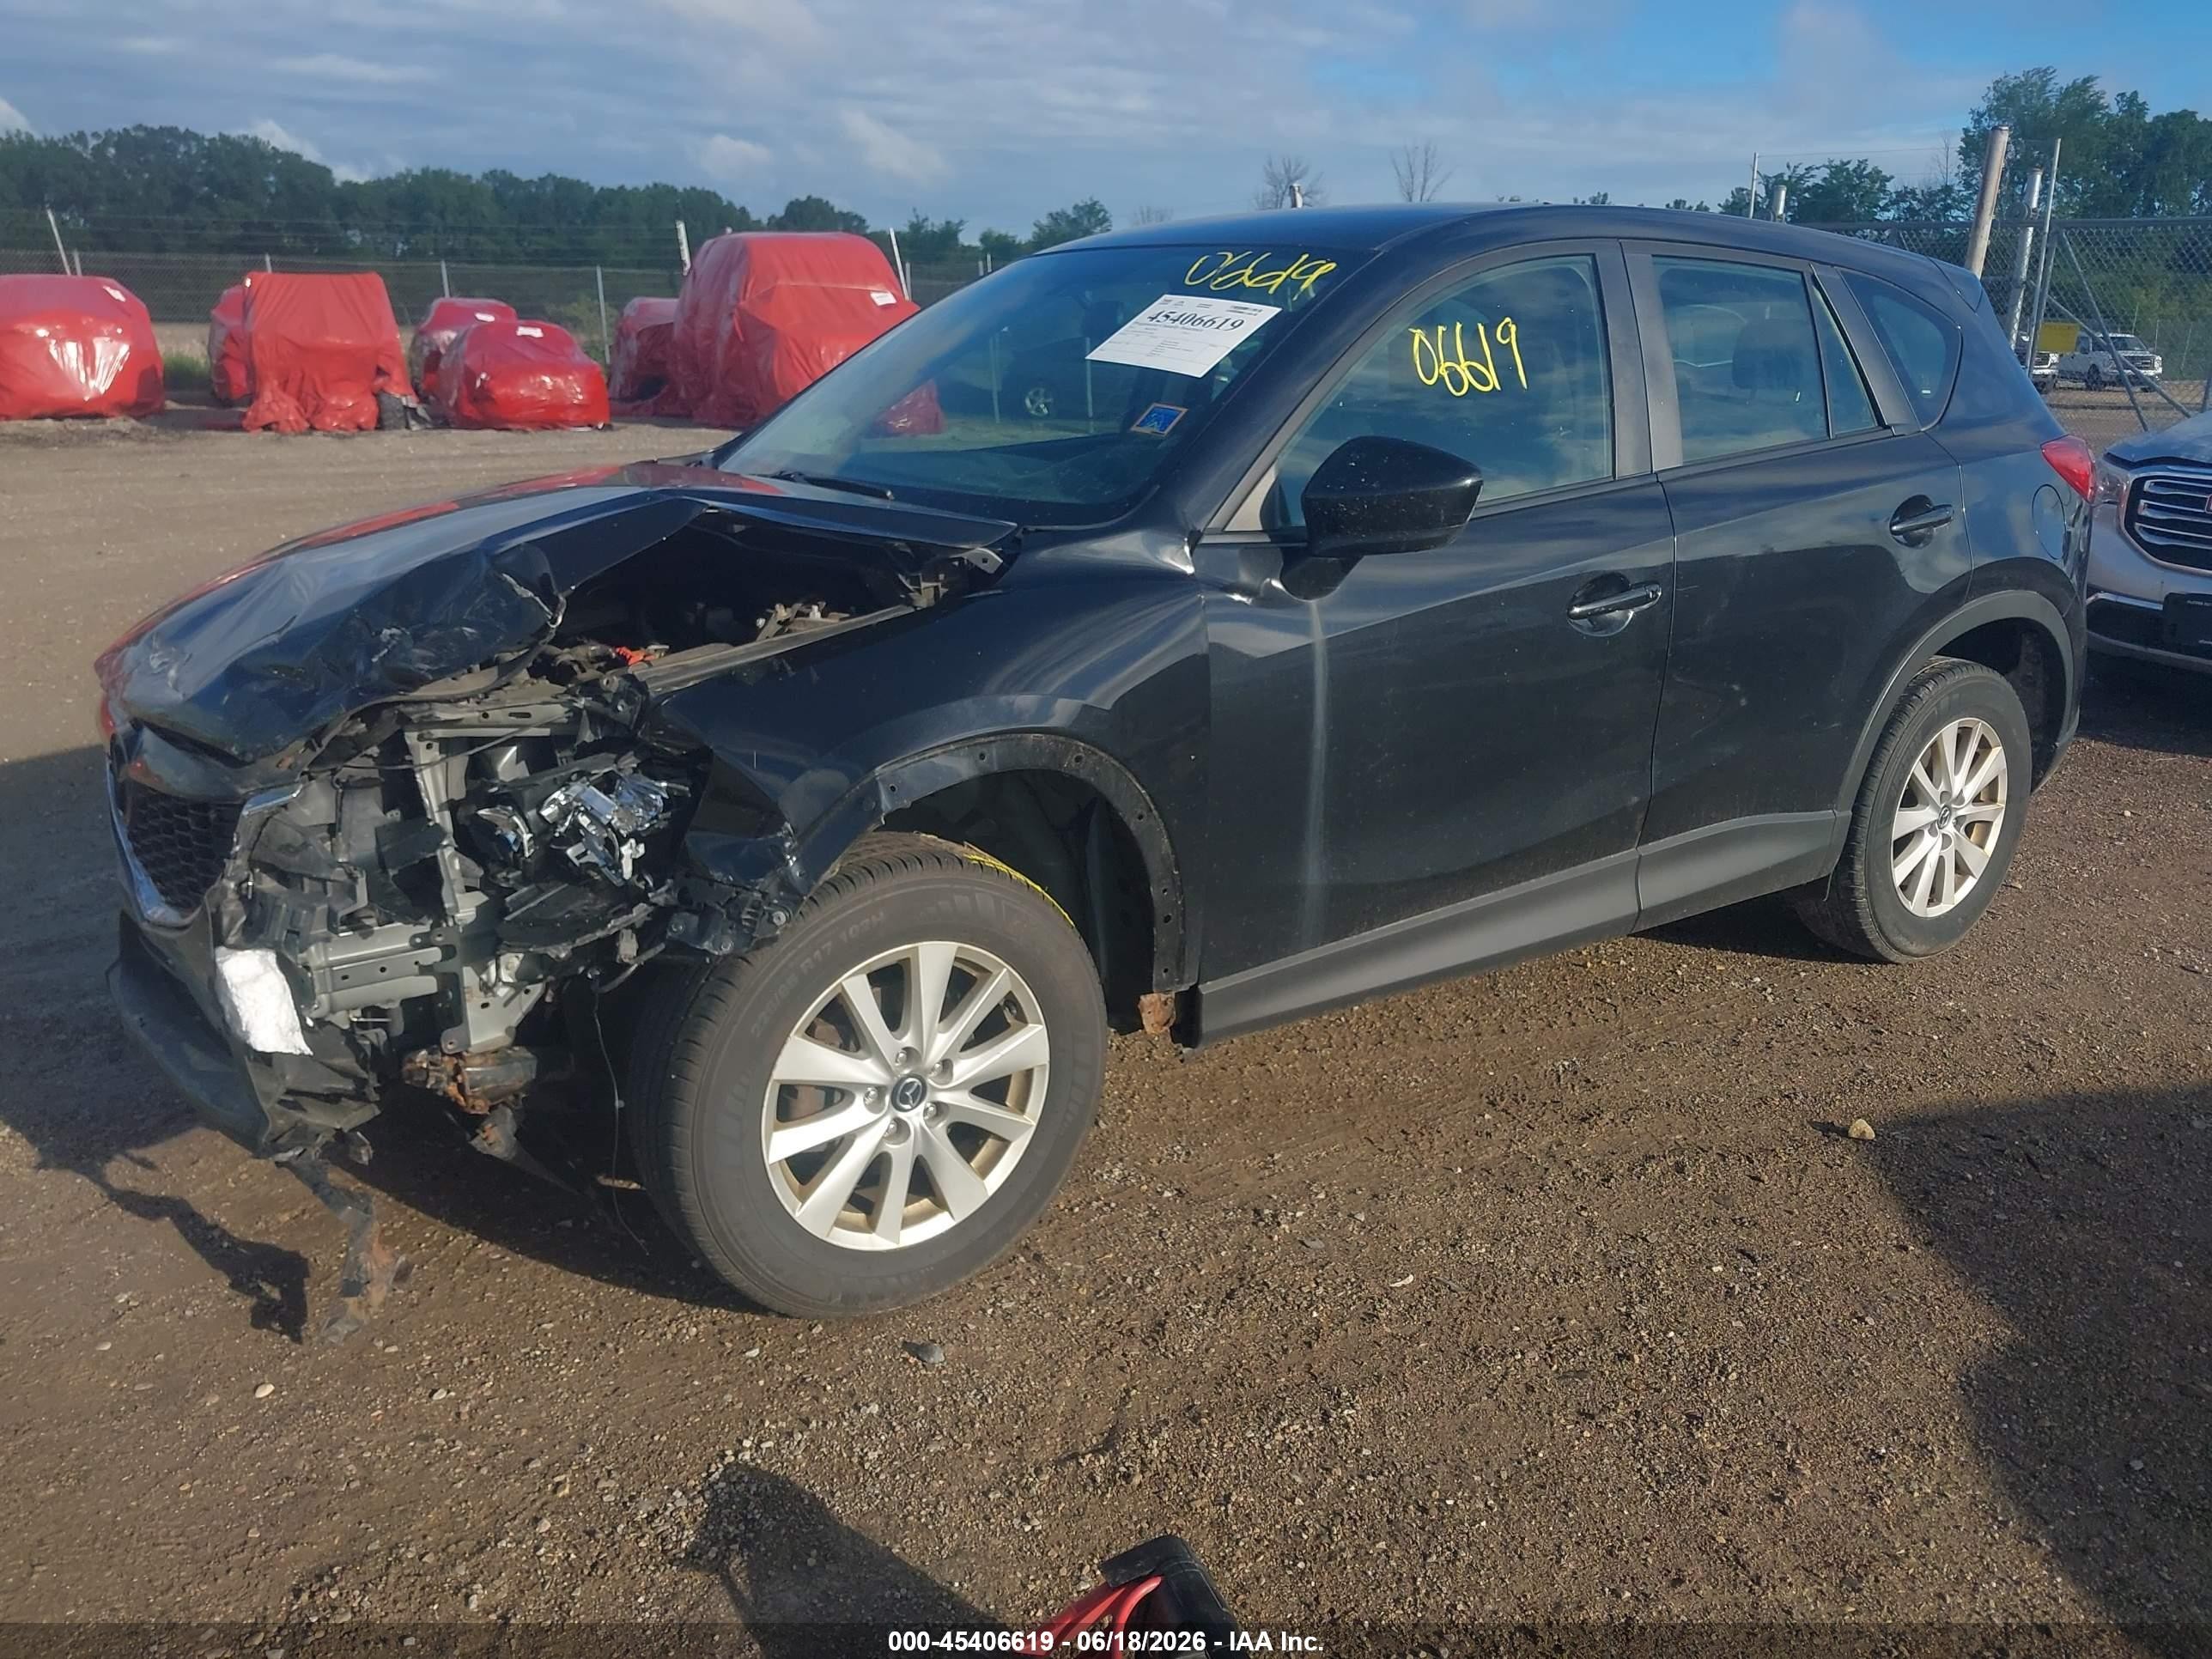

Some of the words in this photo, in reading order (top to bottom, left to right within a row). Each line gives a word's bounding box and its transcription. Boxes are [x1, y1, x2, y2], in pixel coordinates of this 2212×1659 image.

[1183, 250, 1339, 301] 06619
[1146, 309, 1246, 331] 45406619
[1407, 315, 1528, 398] 06619
